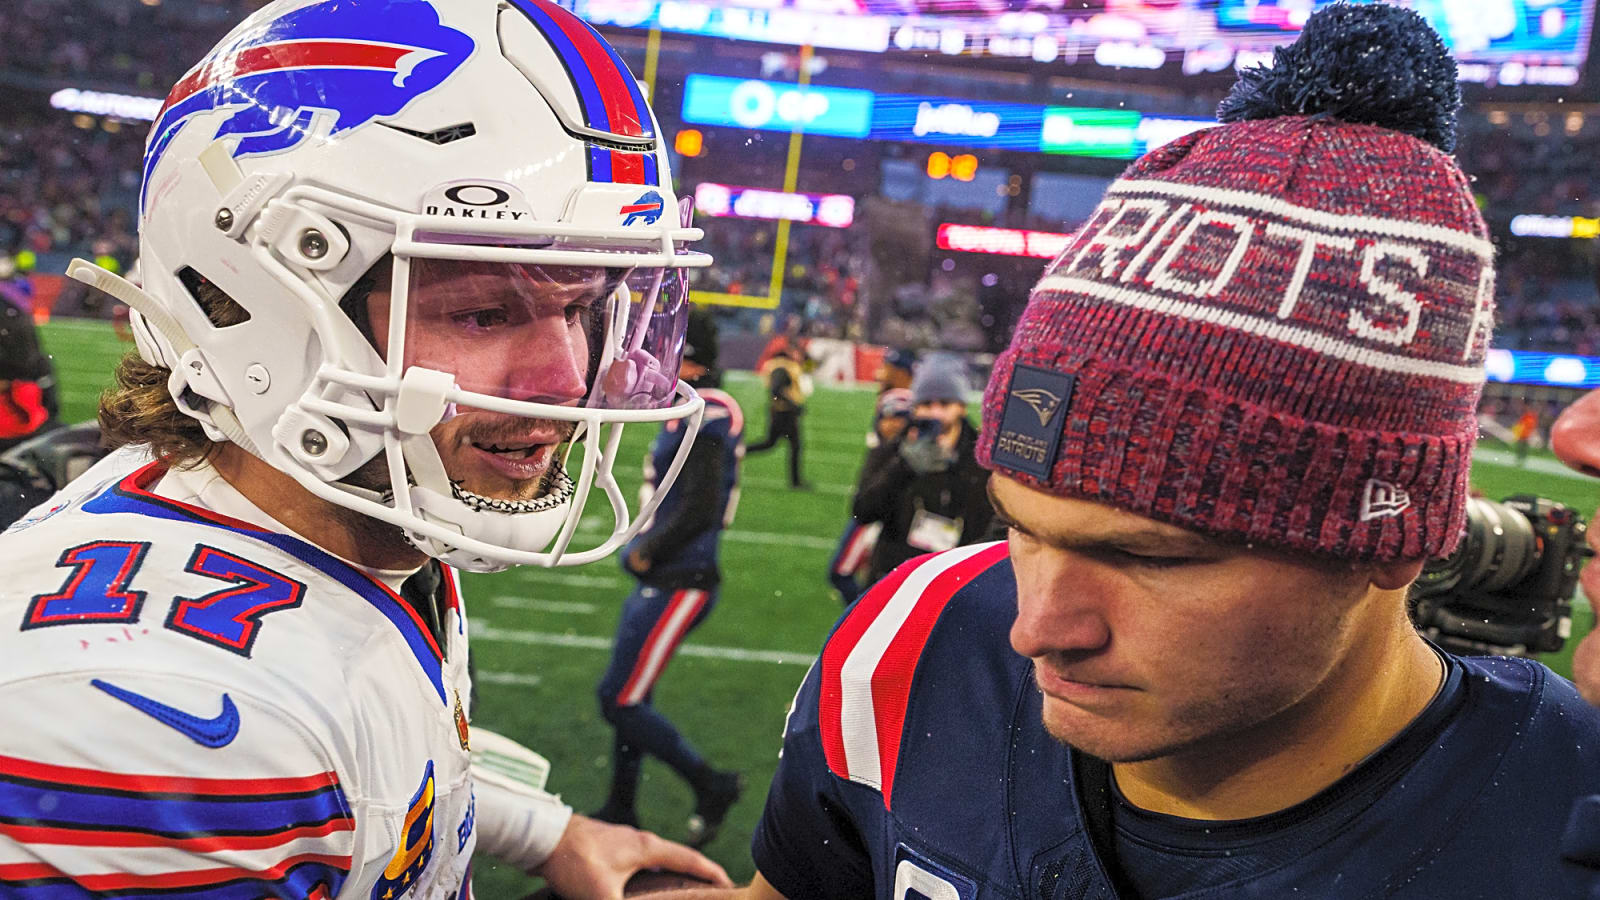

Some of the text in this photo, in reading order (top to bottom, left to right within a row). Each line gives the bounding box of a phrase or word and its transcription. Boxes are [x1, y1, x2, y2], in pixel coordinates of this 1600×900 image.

[426, 205, 524, 221] OAKLEY
[999, 437, 1047, 463] PATRIOTS
[20, 538, 308, 660] 17
